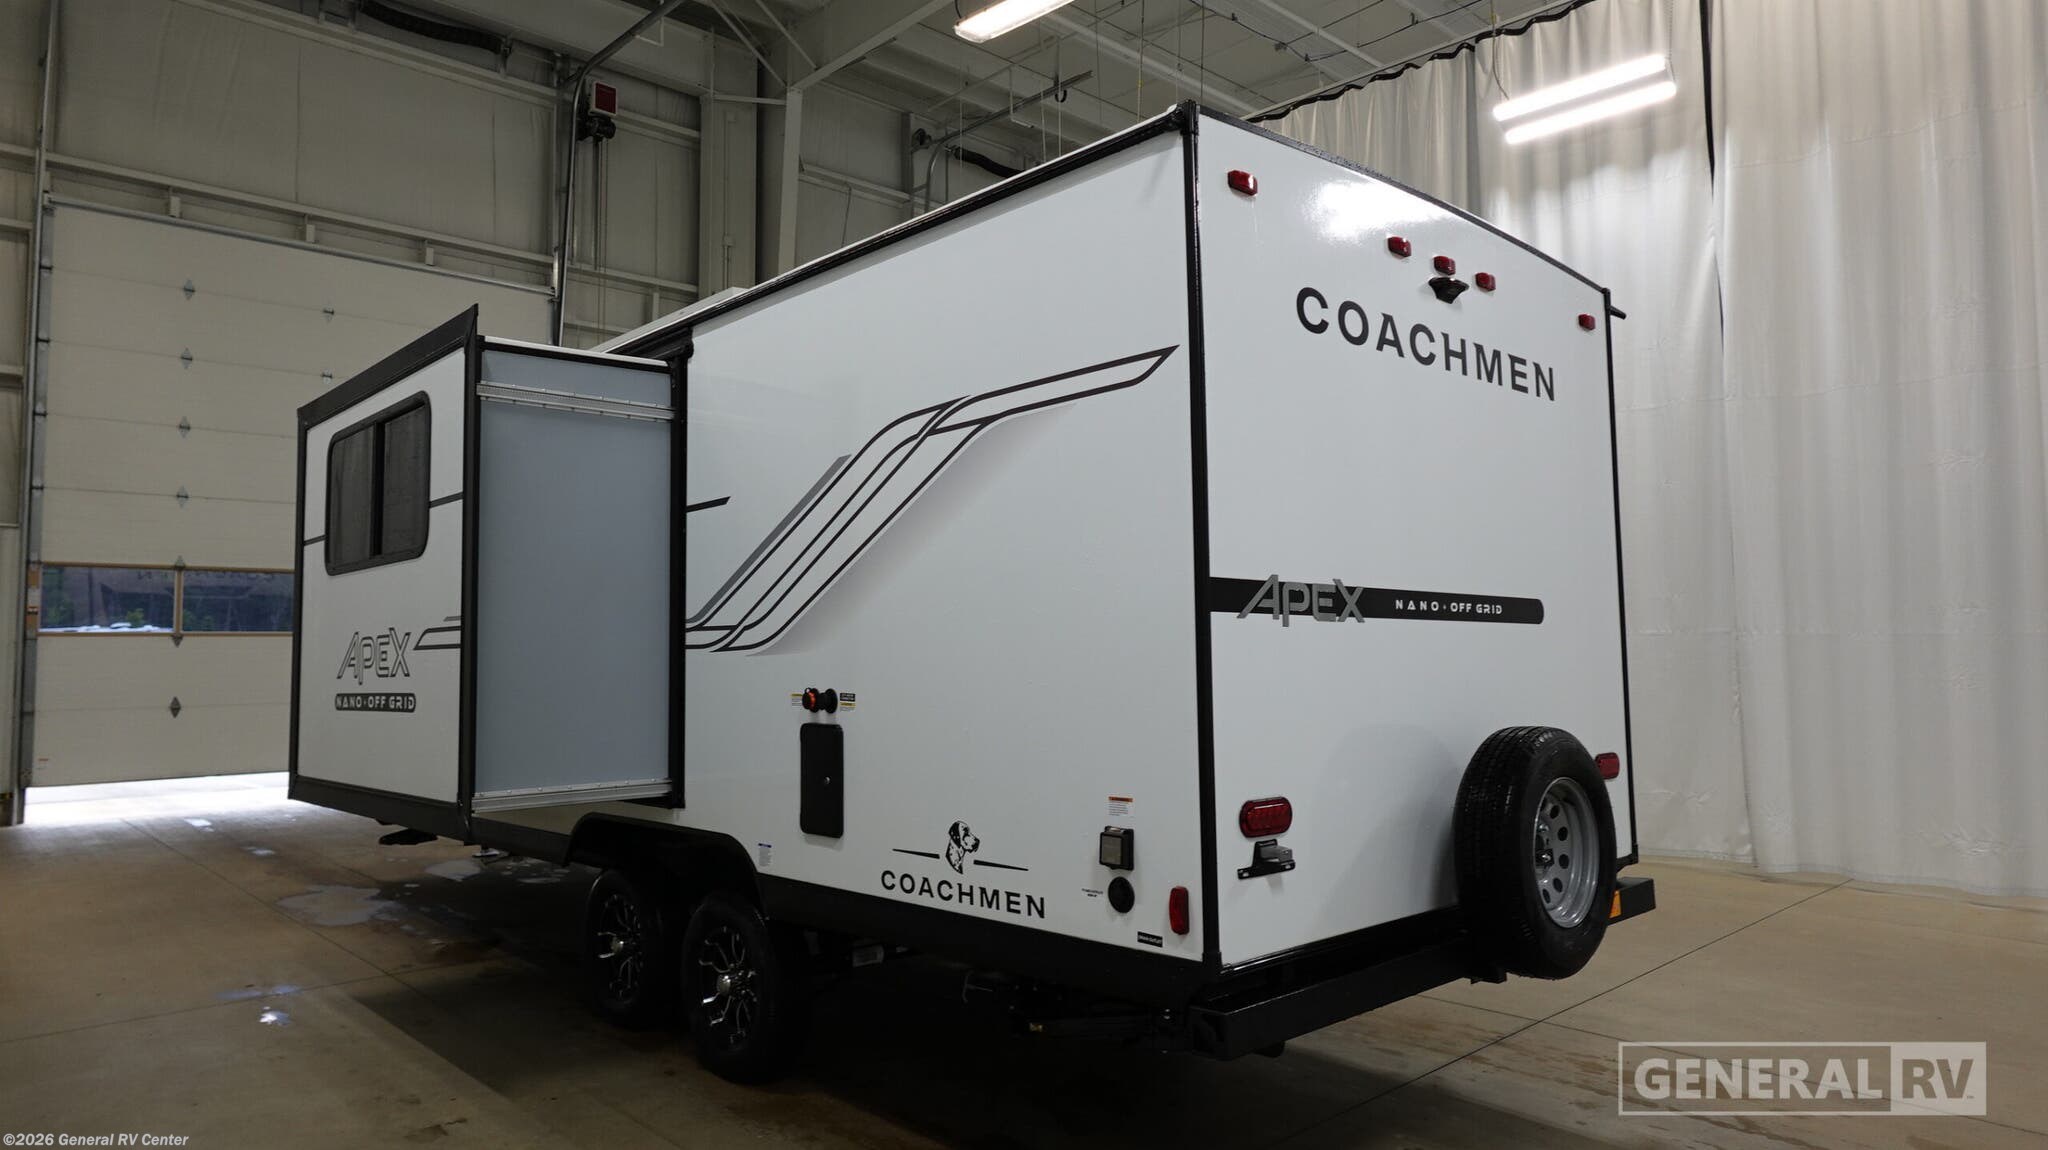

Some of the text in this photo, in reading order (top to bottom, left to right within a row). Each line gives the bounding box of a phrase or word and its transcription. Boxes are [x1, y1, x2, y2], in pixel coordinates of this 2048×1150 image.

[1296, 287, 1556, 402] COACHMEN
[1236, 574, 1503, 628] APEX NANO OFF GRID
[336, 627, 412, 686] APEX
[336, 695, 415, 710] NANO OFF GRID
[881, 870, 1045, 919] COACHMEN
